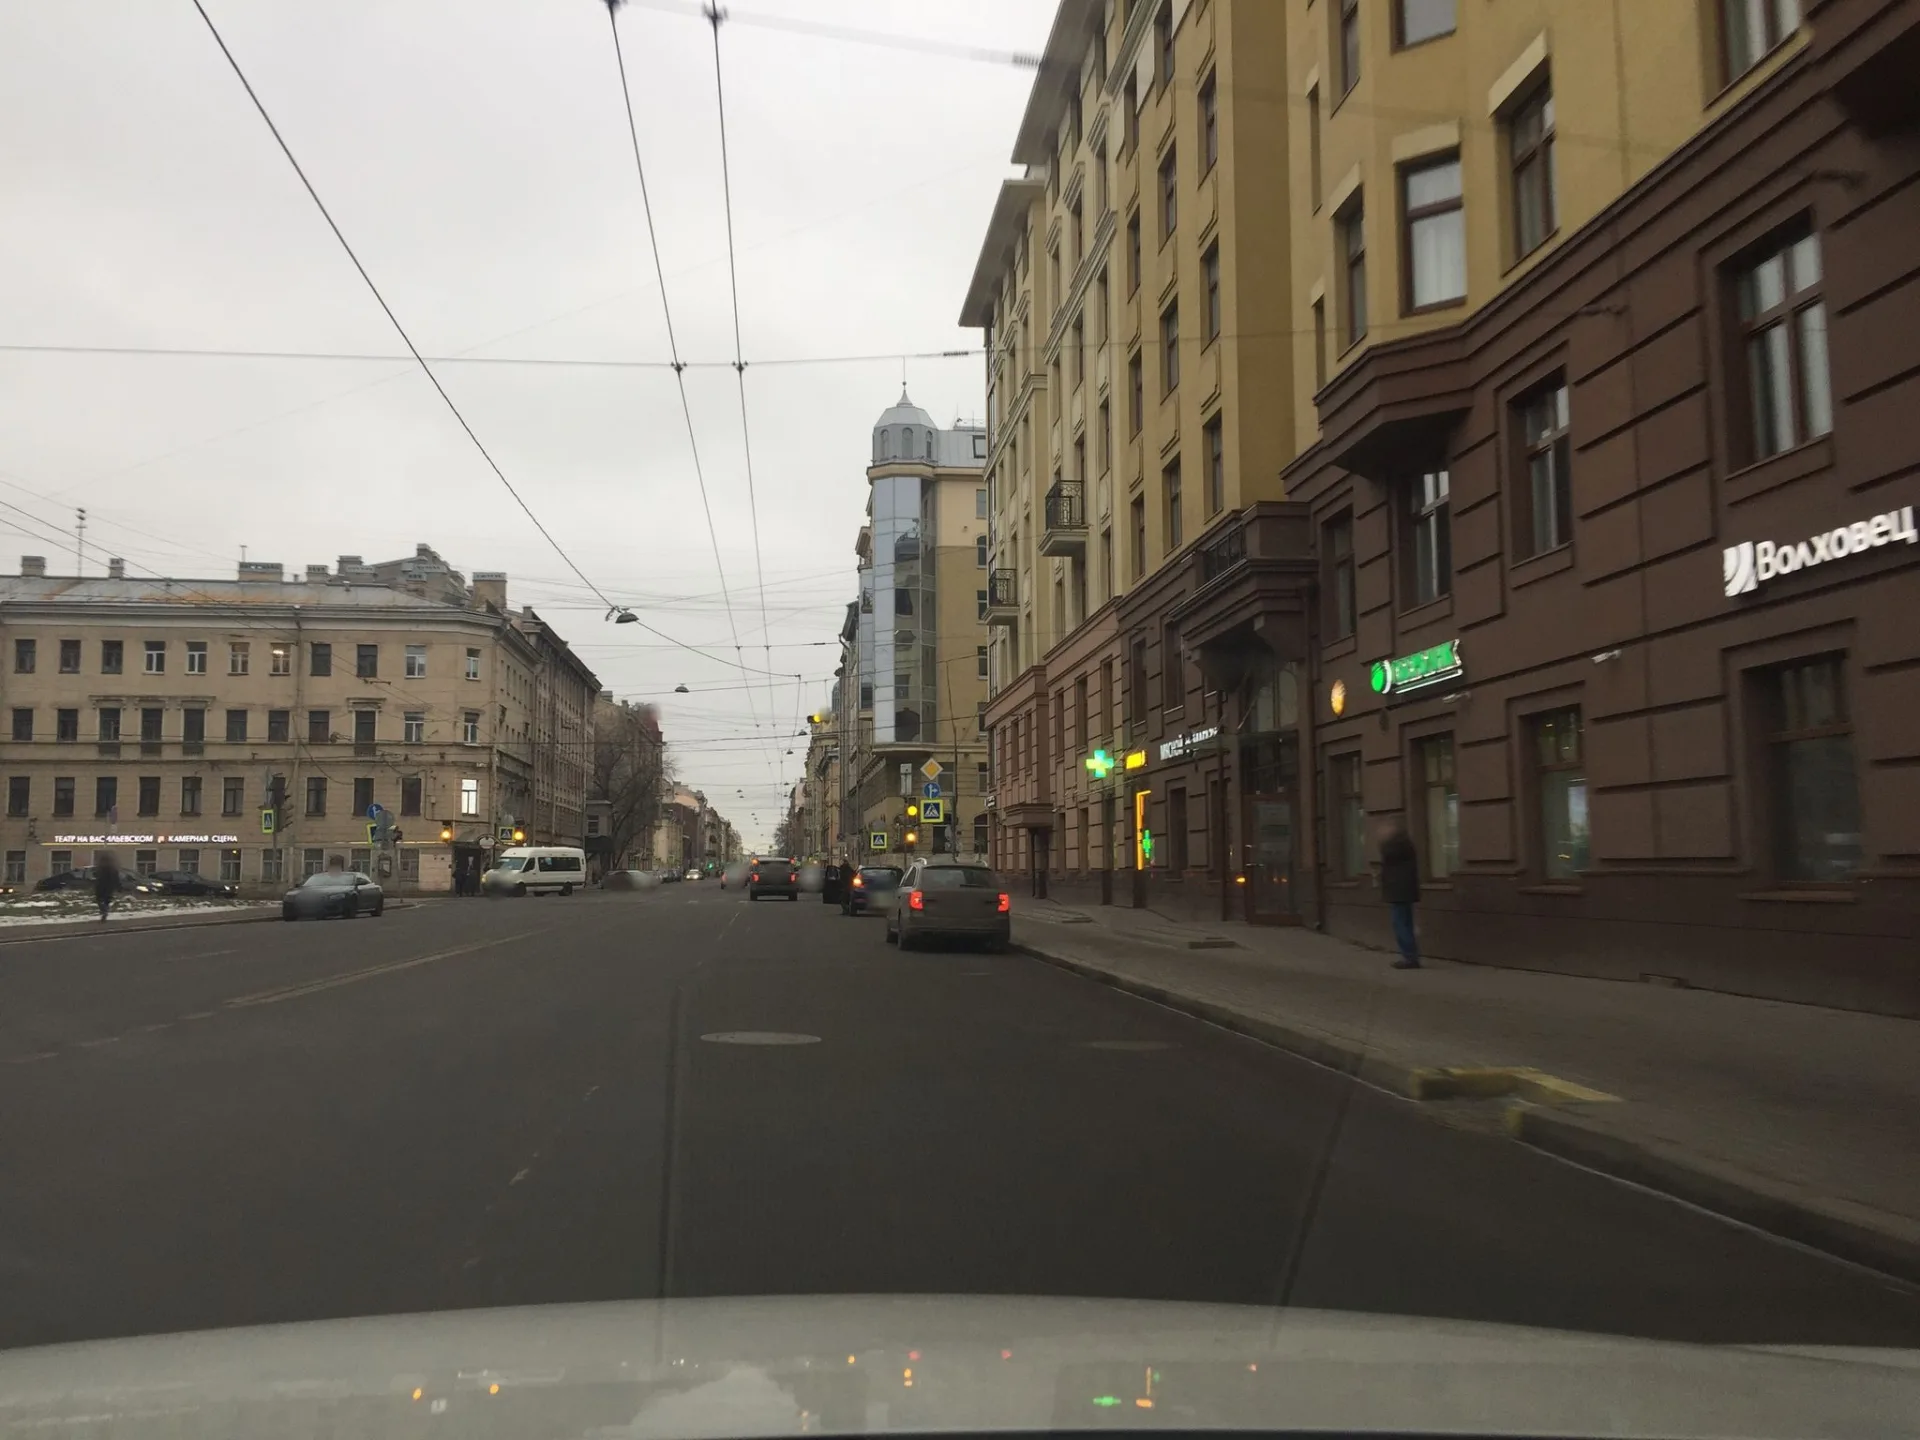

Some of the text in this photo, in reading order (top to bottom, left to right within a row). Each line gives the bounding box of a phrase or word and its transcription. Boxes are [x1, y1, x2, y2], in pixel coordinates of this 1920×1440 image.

[1756, 506, 1918, 581] Волховец
[54, 835, 75, 843] ТЕАТР
[77, 835, 88, 843] НА
[168, 835, 238, 843] КАМЕРНАЯ СЦЕНА
